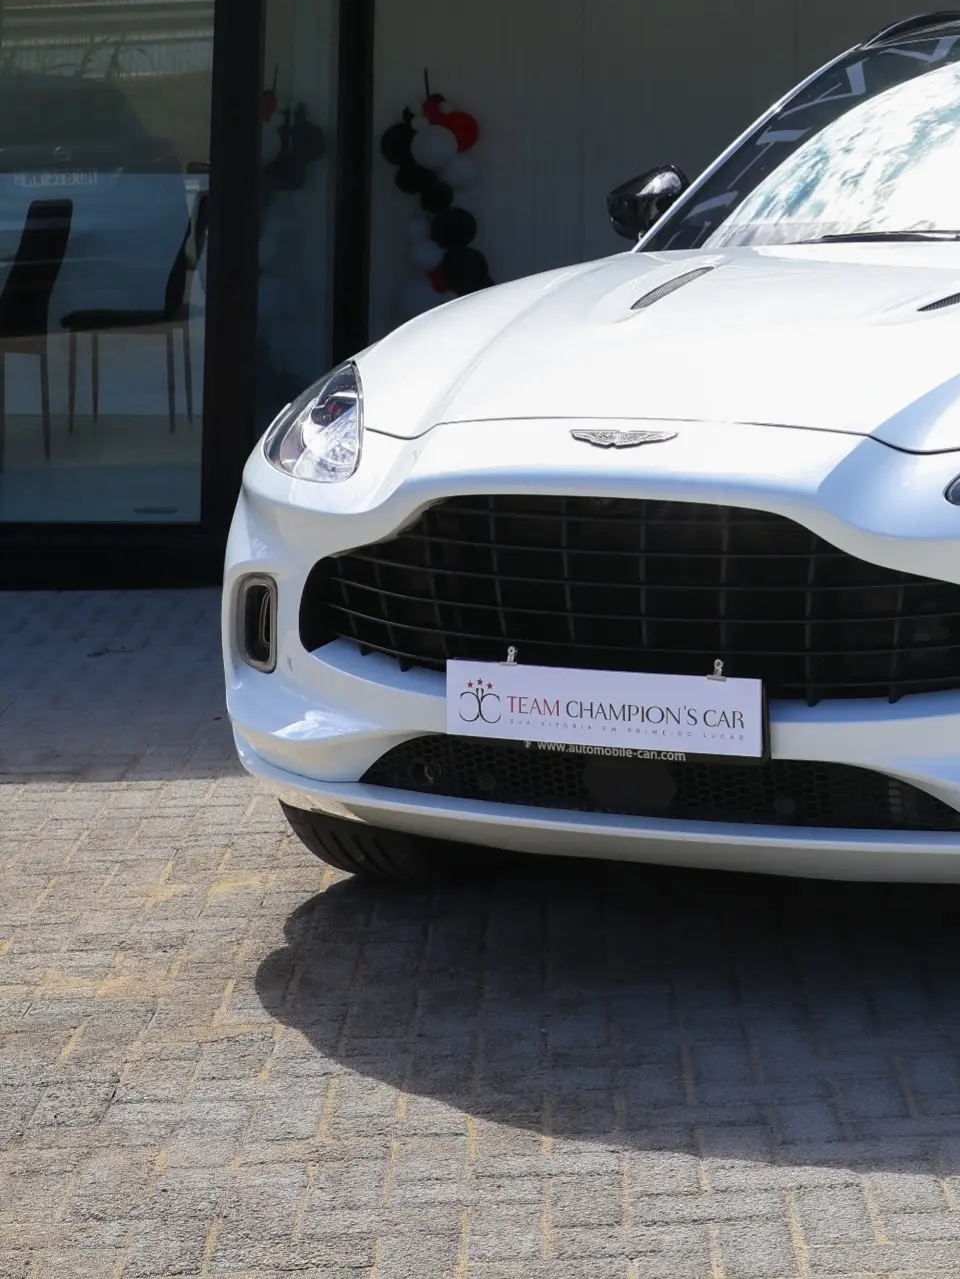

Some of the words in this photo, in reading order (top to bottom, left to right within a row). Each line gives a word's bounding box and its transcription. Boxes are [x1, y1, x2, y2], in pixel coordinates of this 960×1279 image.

[507, 695, 560, 717] TEAM
[565, 700, 698, 727] CHAMPION'S
[703, 709, 745, 729] CAR
